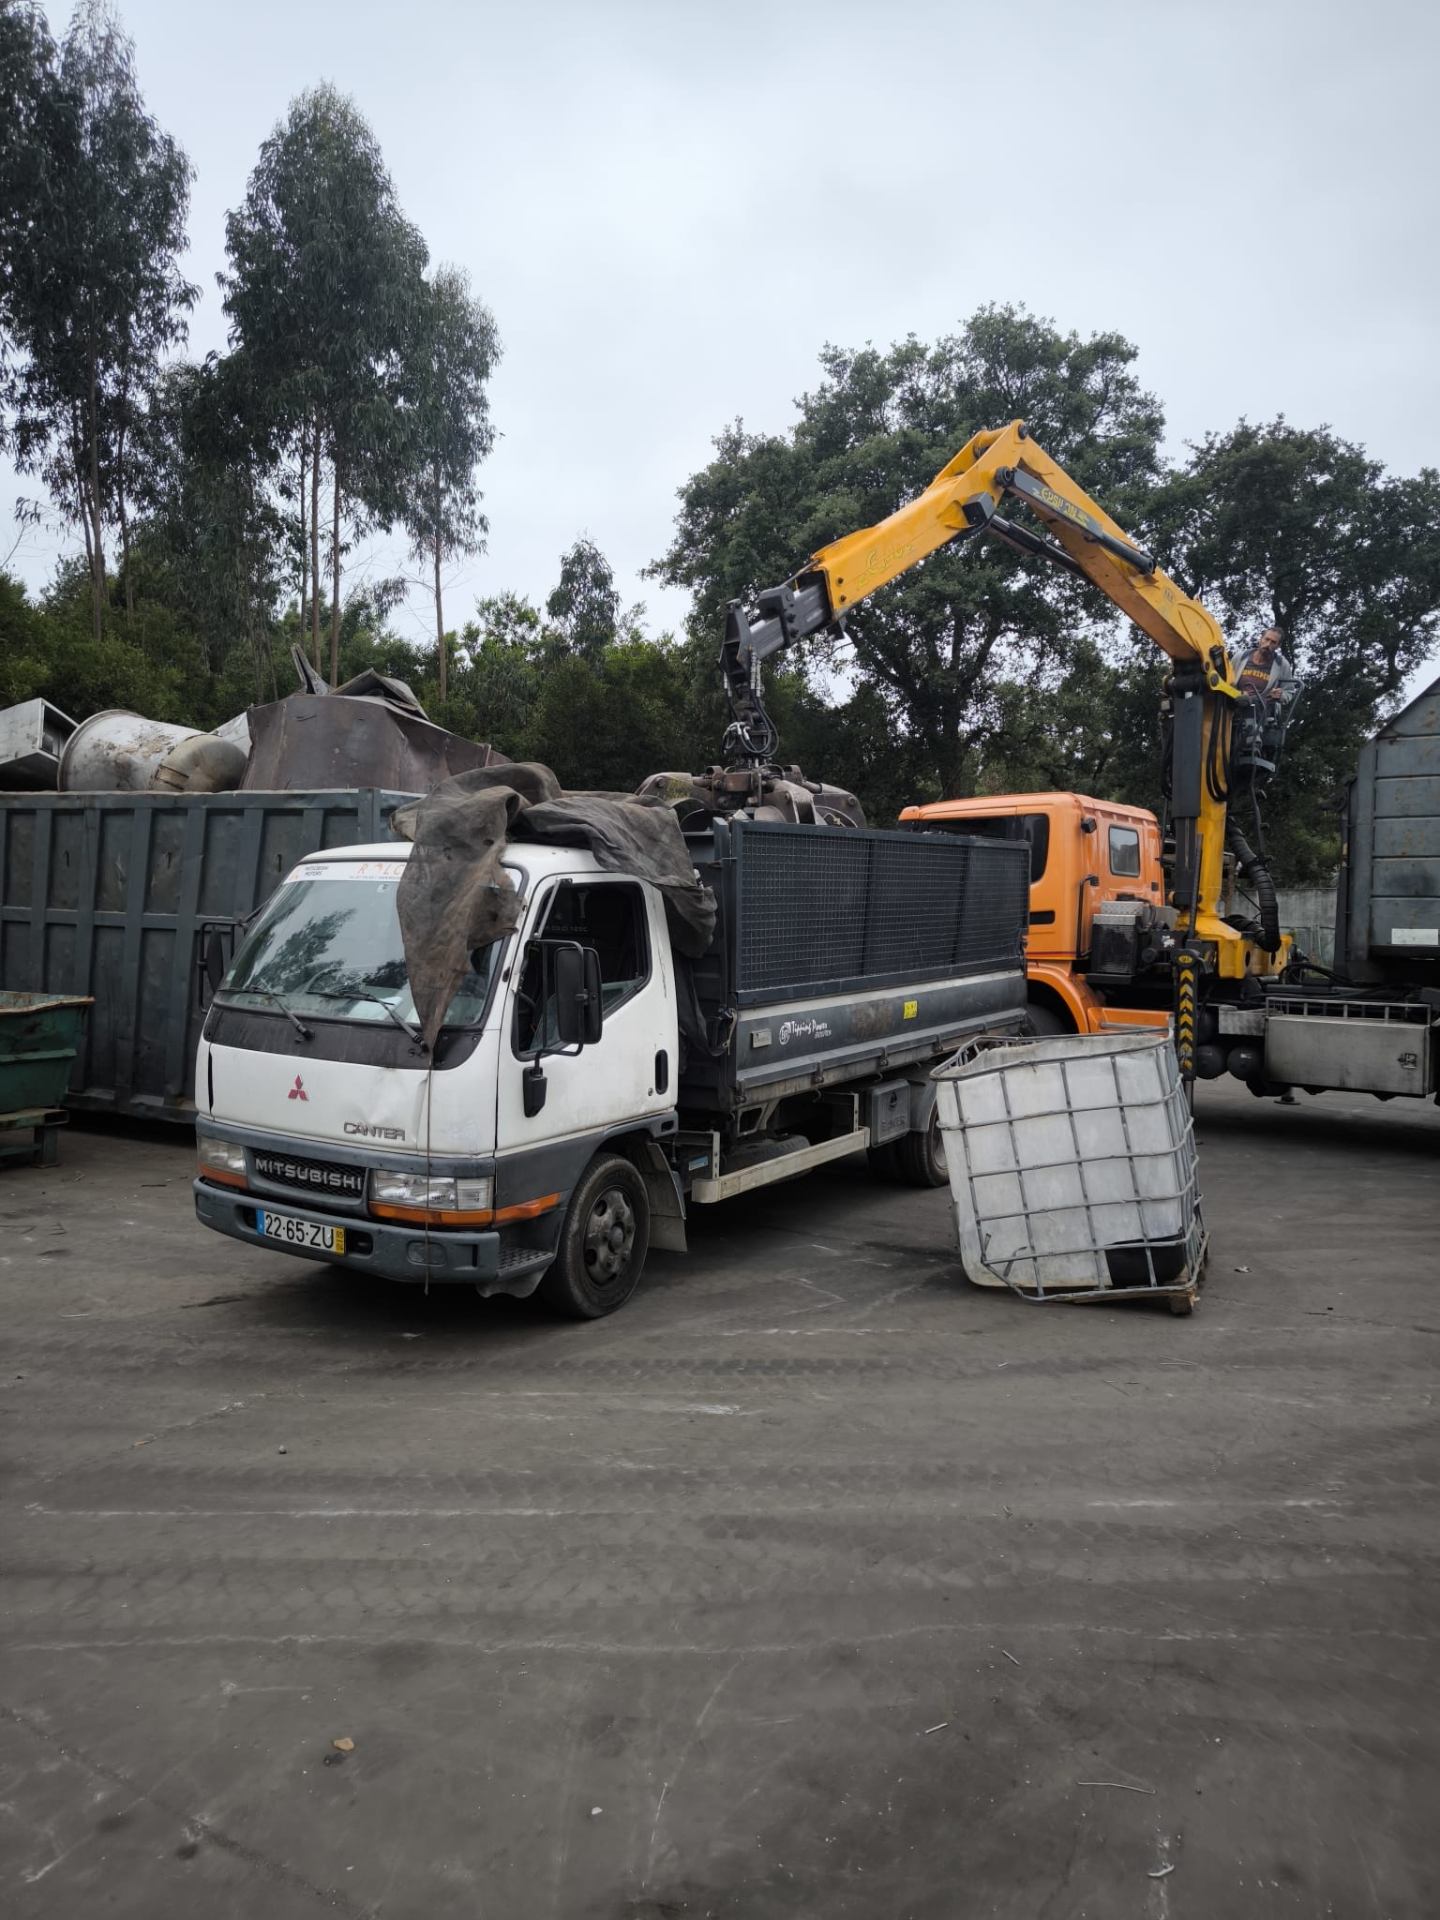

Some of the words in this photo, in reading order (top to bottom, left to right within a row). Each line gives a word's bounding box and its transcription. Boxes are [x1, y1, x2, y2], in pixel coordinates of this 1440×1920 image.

[791, 1020, 812, 1037] Tipping
[344, 1122, 406, 1141] CANTER
[255, 1158, 362, 1190] MITSUBISHI
